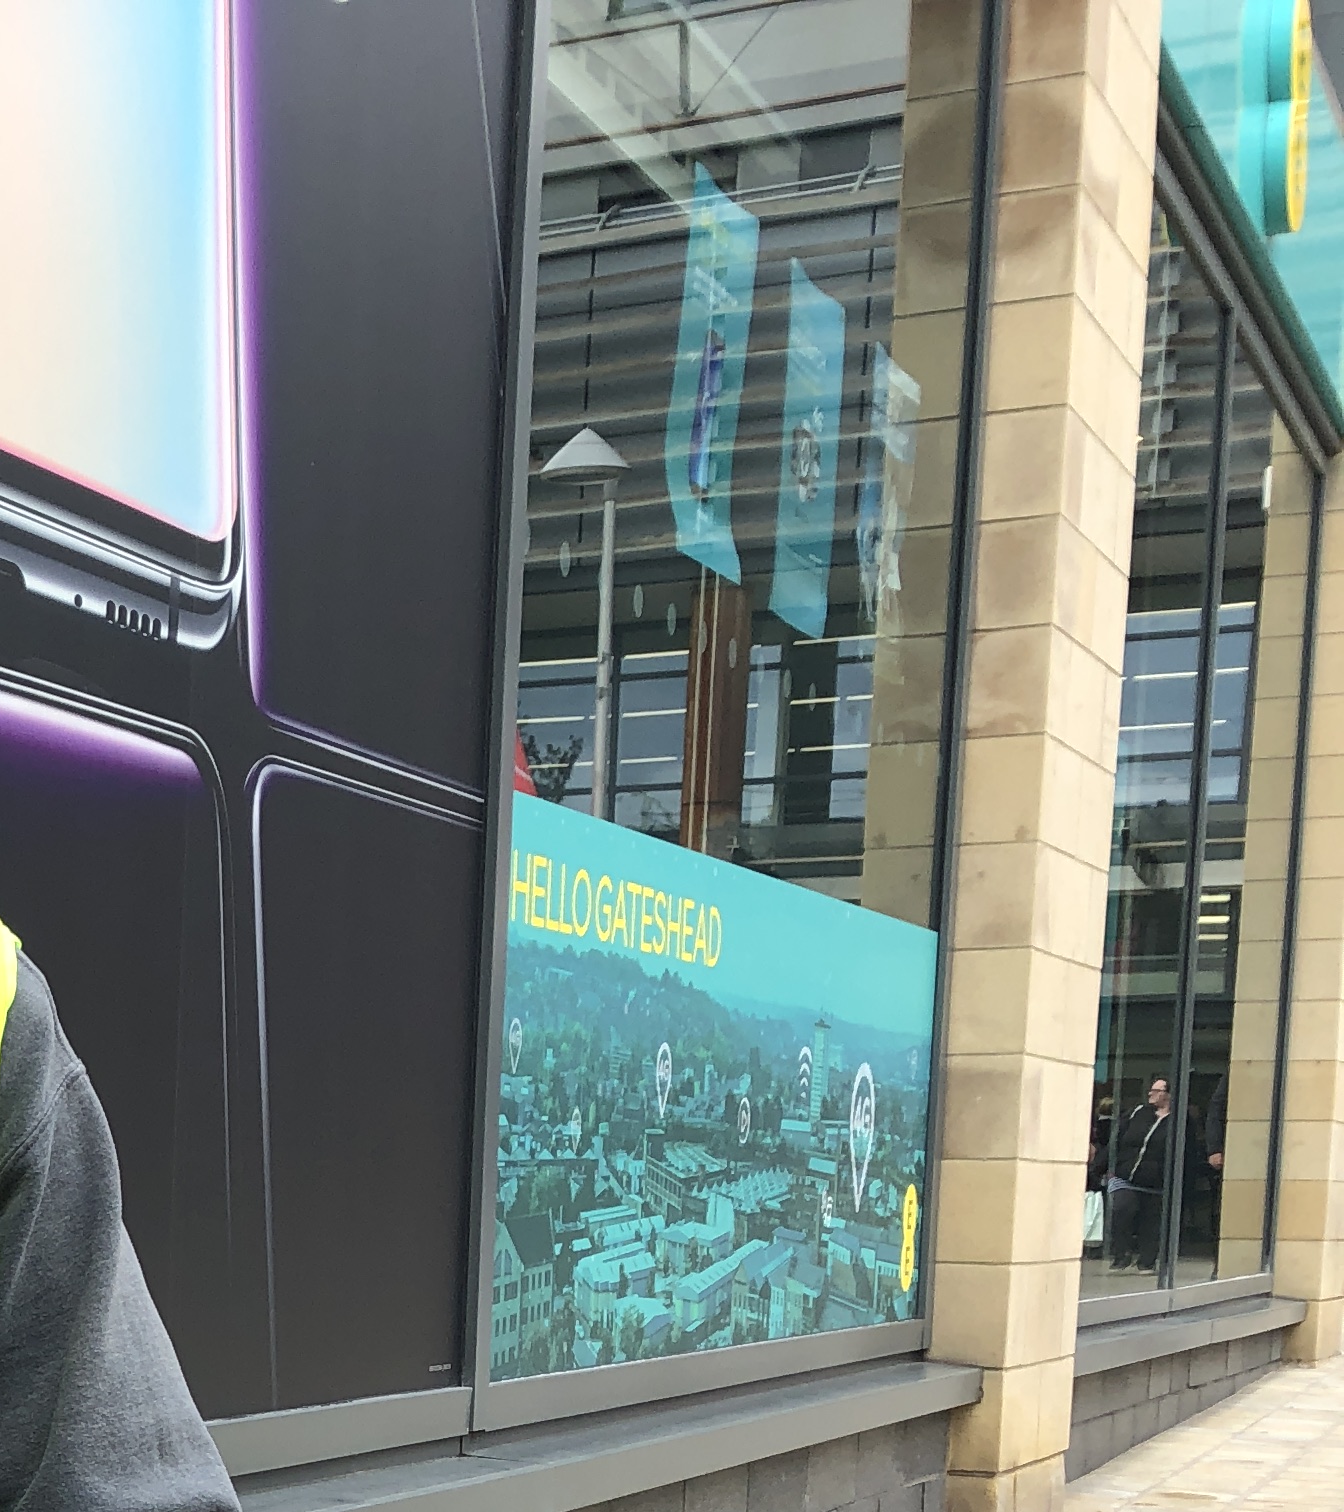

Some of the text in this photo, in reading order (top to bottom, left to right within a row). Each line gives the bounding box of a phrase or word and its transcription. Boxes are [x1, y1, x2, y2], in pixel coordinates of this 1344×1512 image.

[511, 849, 722, 968] HELLO GATESHEAD
[853, 1096, 871, 1138] 4G
